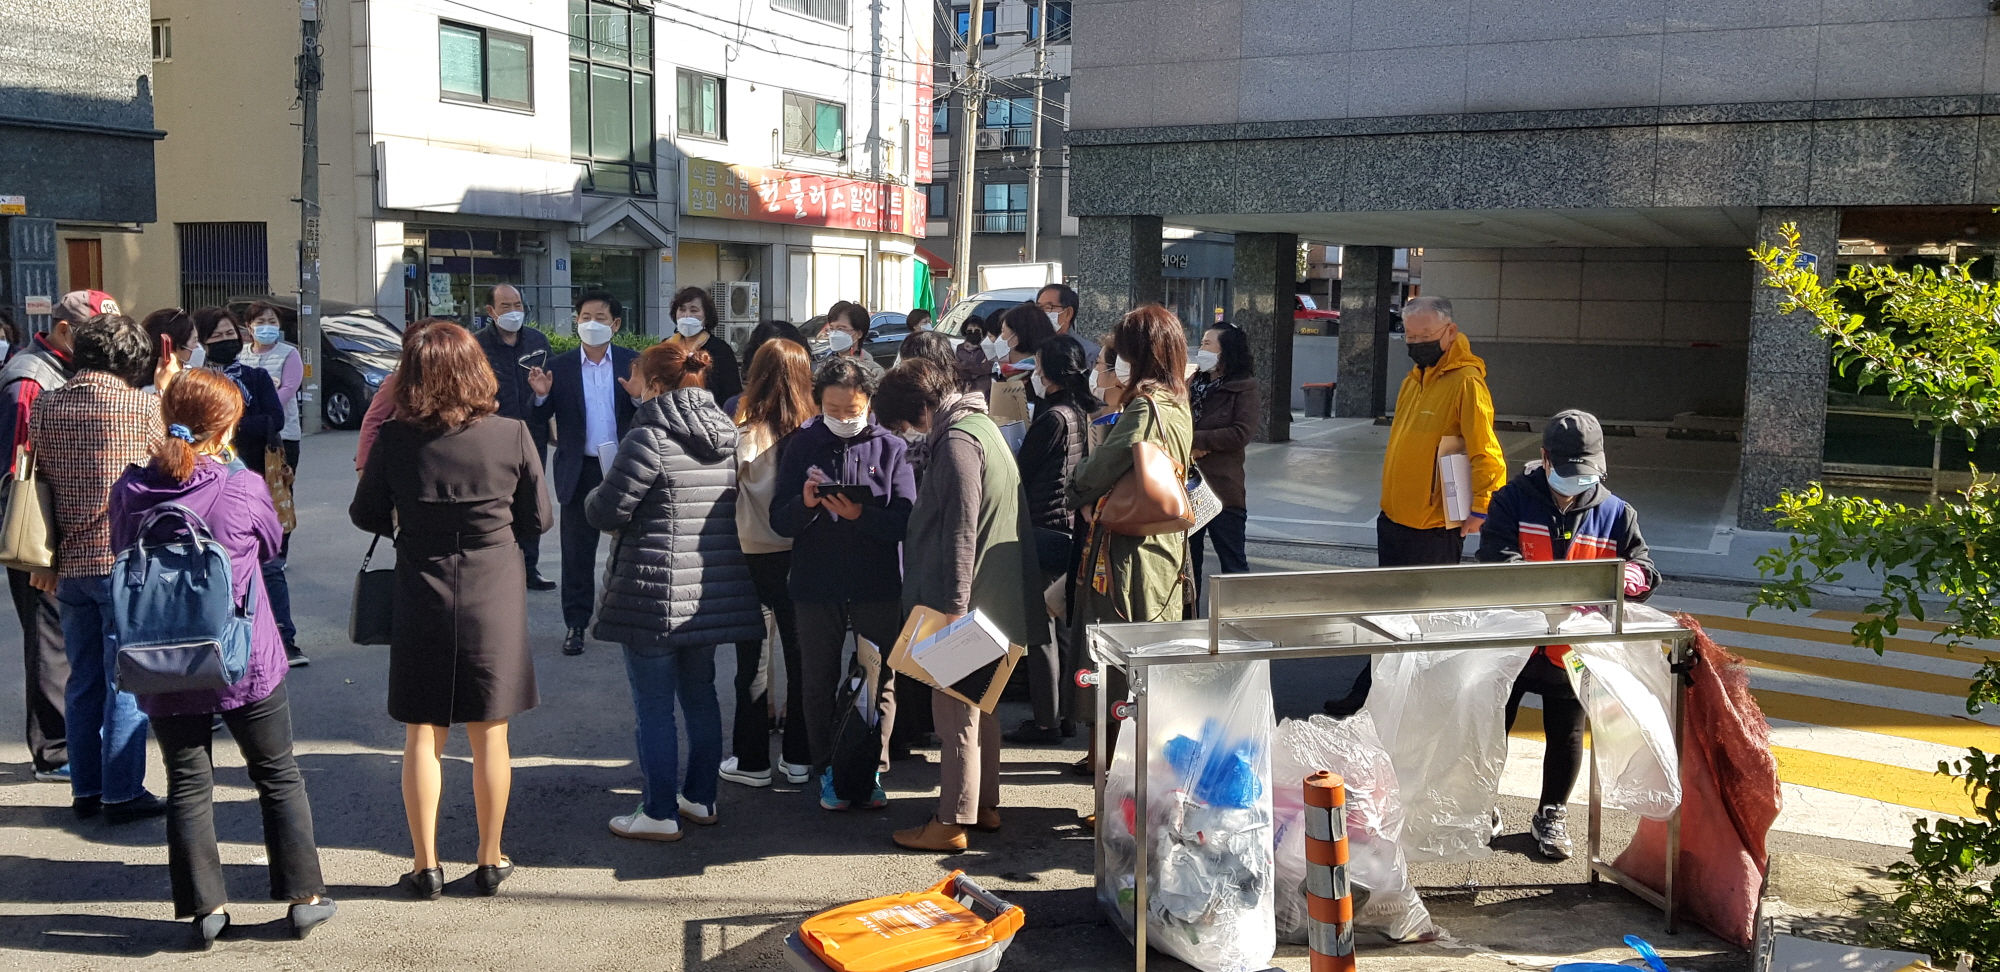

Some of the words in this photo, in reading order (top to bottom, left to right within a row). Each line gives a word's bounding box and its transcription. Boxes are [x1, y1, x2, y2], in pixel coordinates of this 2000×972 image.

[918, 97, 930, 168] 할인마트
[692, 188, 749, 215] 잡화·야채
[850, 185, 903, 216] 할인마트
[856, 217, 898, 230] 406-9906
